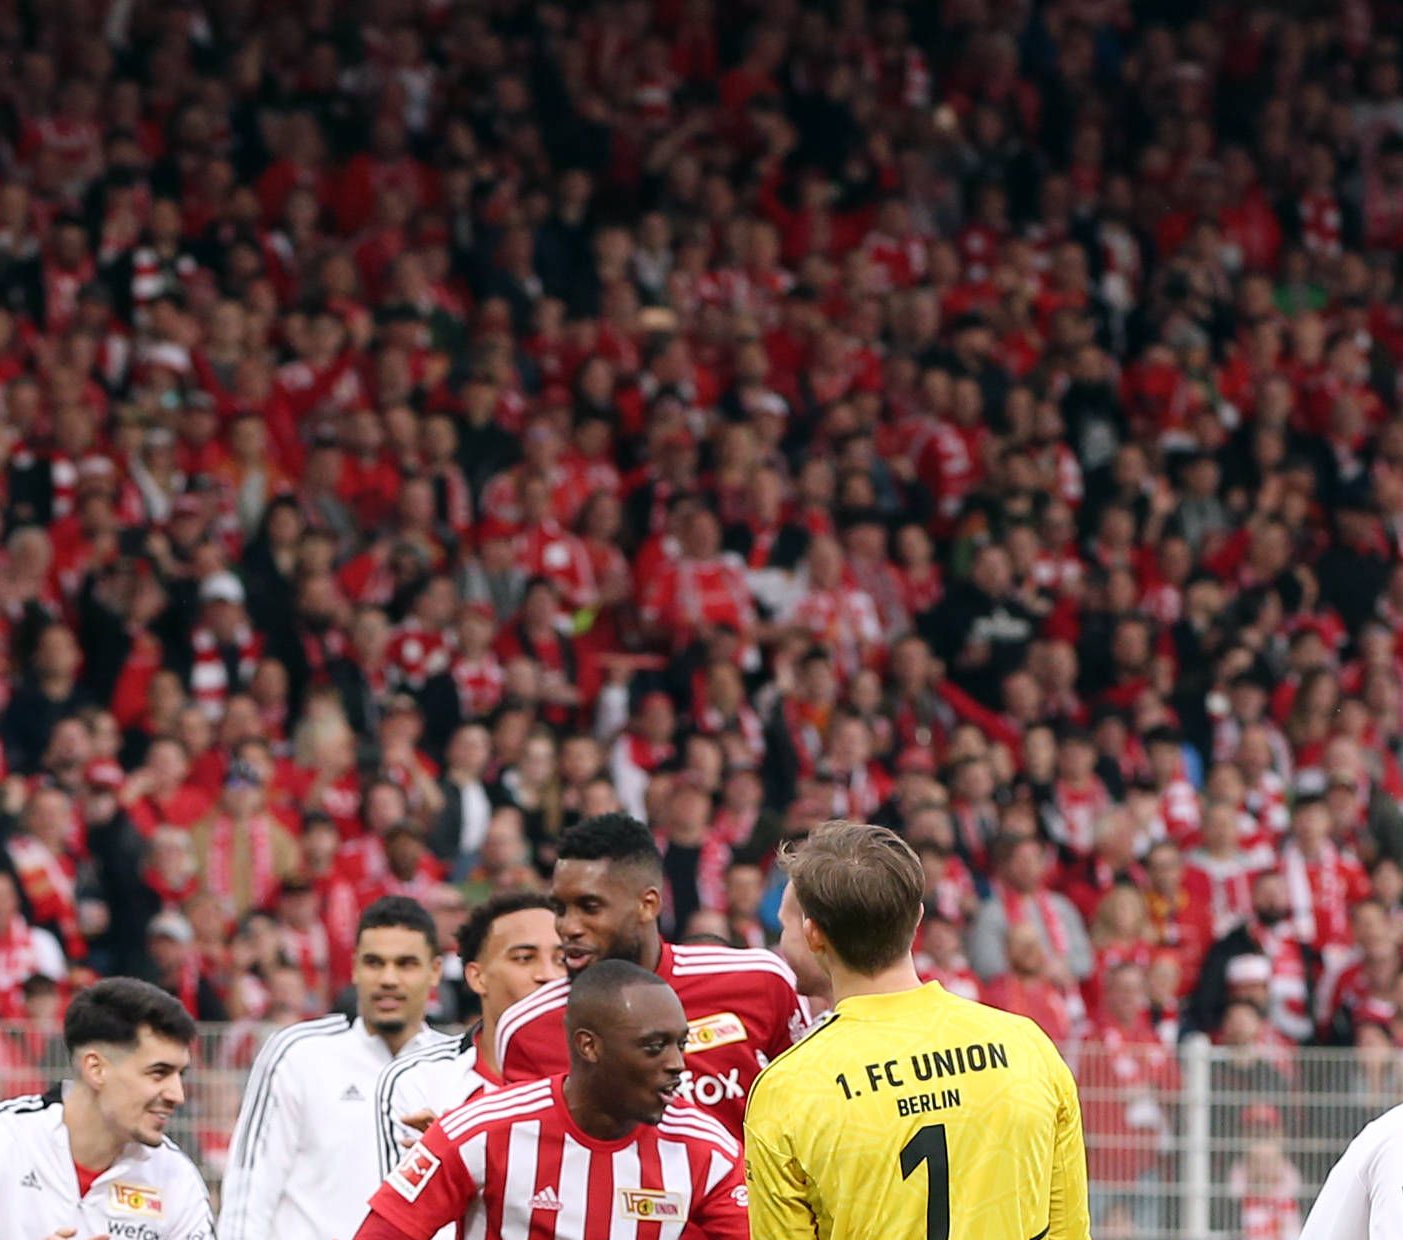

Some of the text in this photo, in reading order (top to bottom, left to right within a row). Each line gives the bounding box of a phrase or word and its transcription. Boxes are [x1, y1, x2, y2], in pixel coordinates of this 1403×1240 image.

[677, 1068, 745, 1105] fox
[835, 1042, 1009, 1100] 1. FC UNION
[896, 1088, 961, 1118] BERLIN
